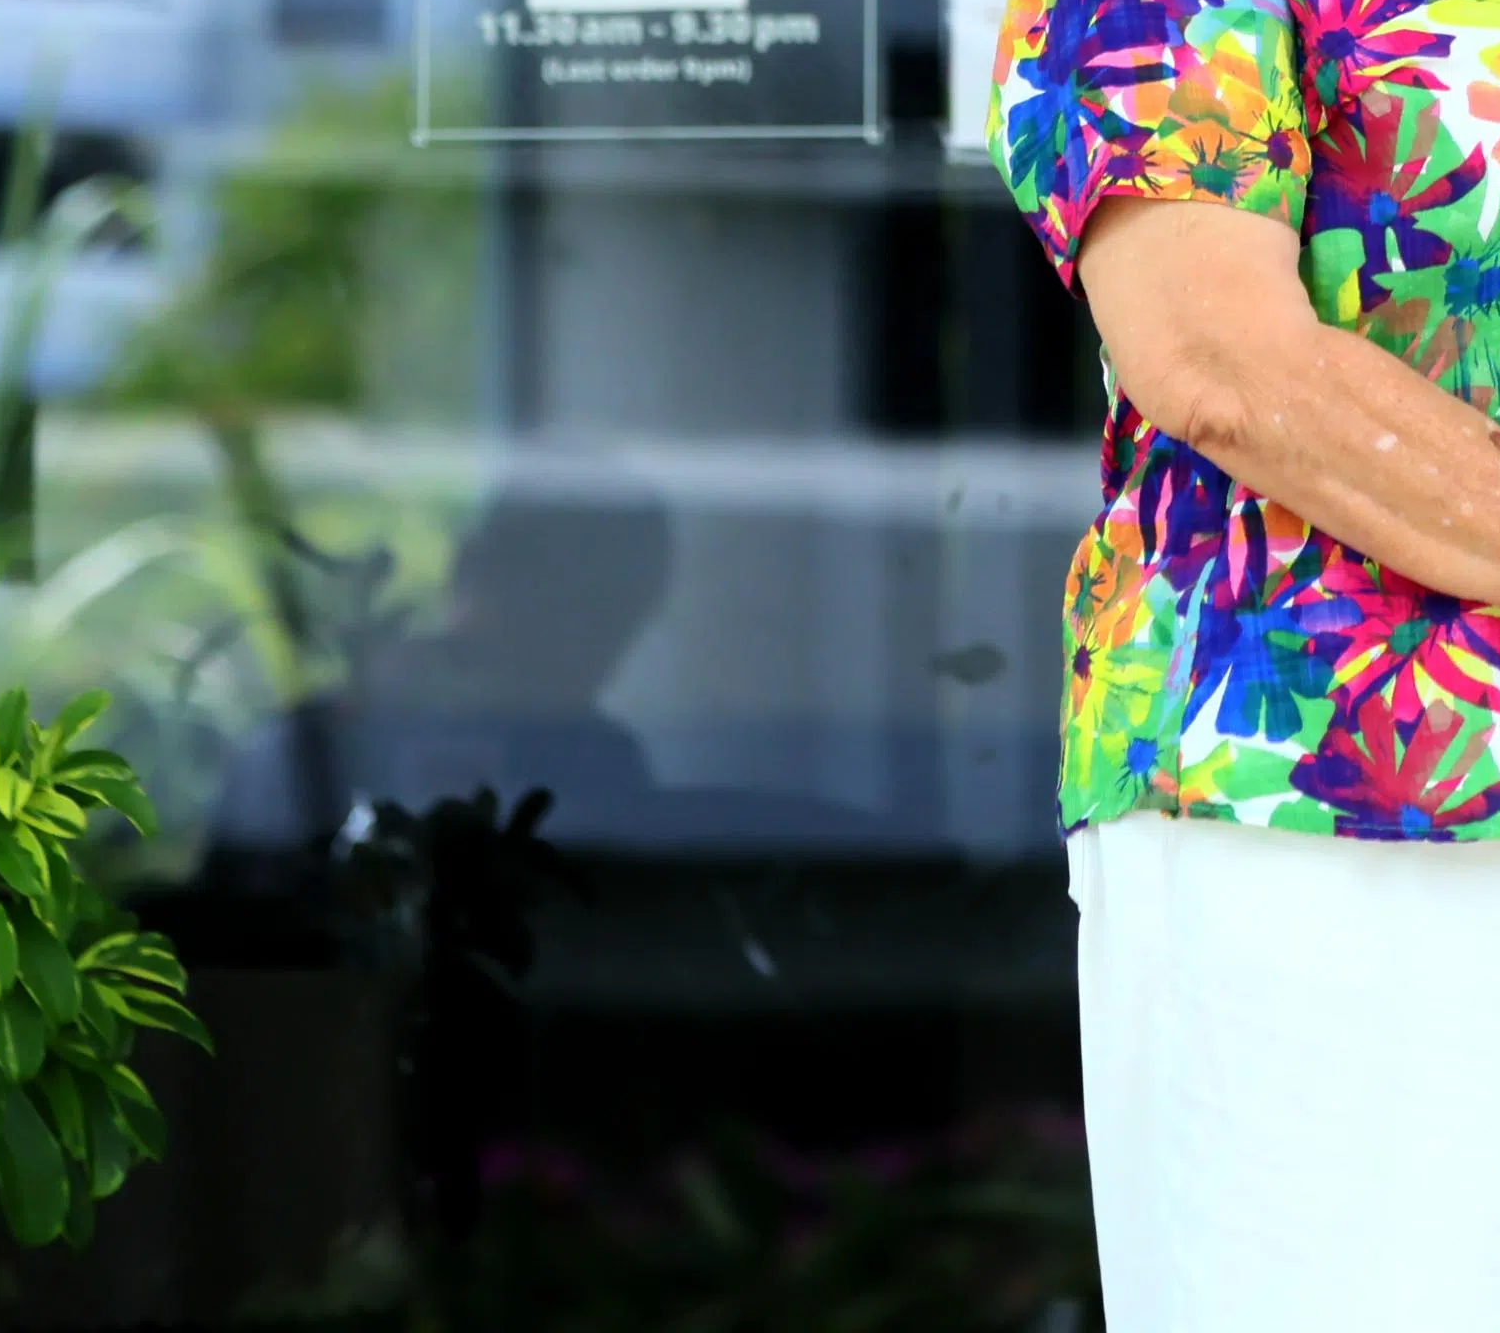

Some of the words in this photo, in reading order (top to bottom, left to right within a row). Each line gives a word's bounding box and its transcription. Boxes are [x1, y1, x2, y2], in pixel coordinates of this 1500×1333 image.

[480, 12, 643, 45] 11.30am
[670, 12, 819, 53] 9.30pm
[542, 56, 605, 84] (Last
[608, 57, 678, 83] order
